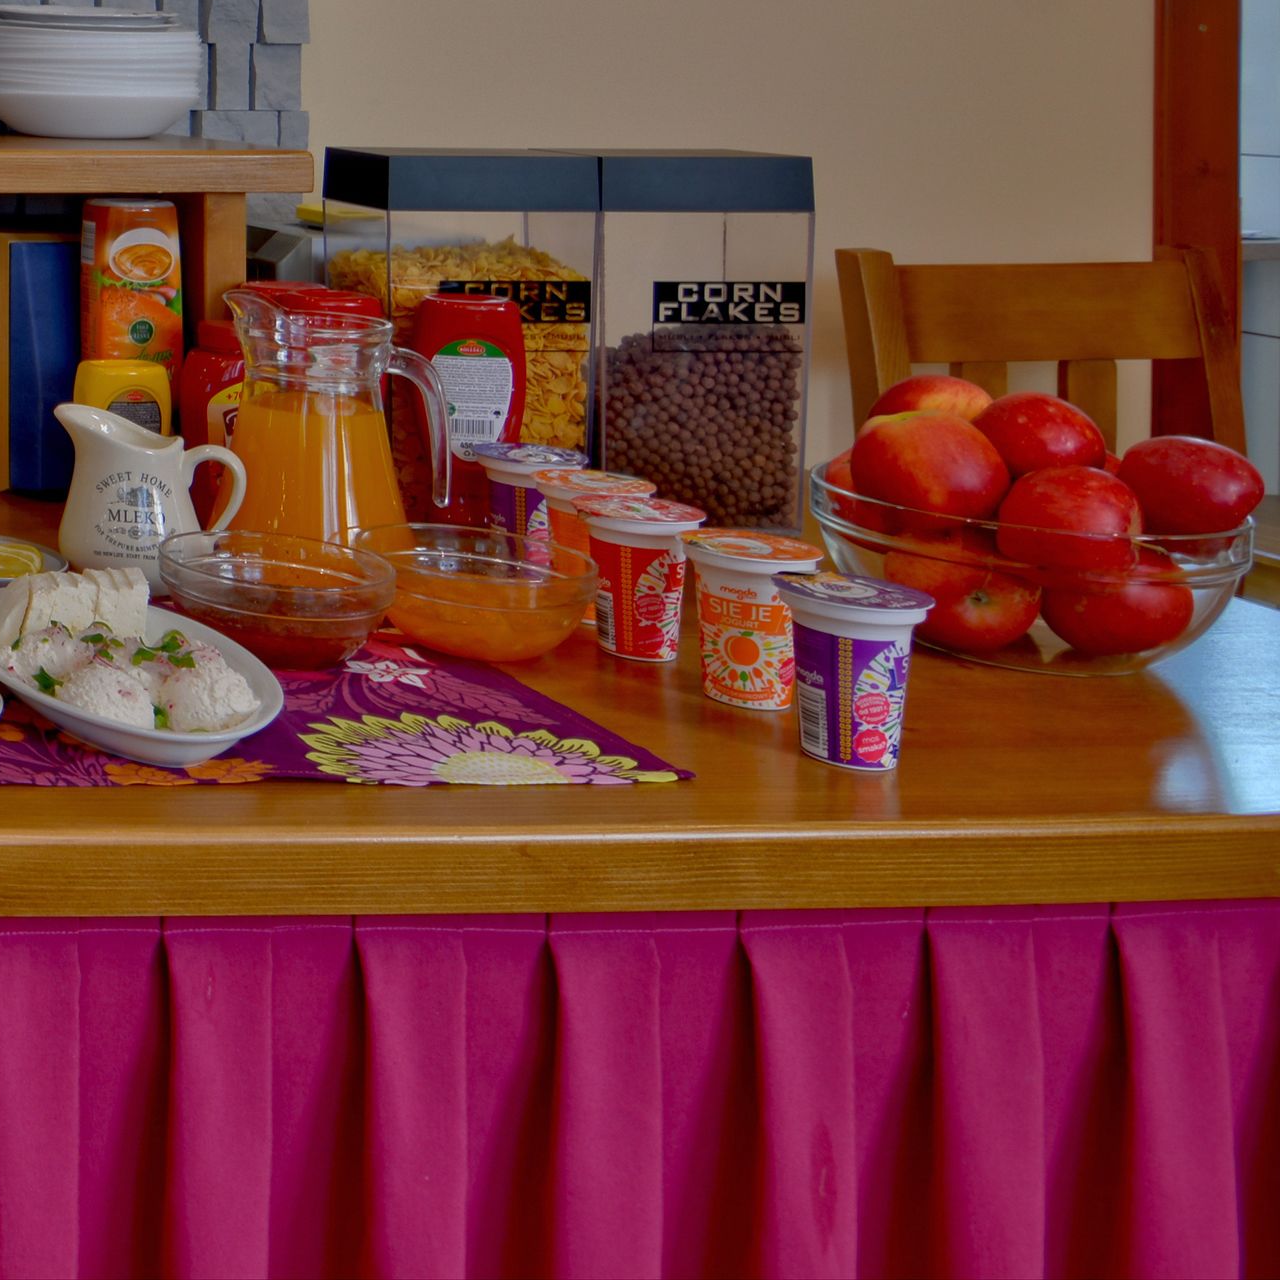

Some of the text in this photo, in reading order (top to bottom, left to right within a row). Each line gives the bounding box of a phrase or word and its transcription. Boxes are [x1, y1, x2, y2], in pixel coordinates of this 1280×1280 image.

[677, 283, 783, 303] CORN
[519, 302, 586, 322] KES
[658, 302, 800, 322] FLAKES
[95, 471, 173, 498] SWEET HOME
[720, 584, 758, 600] magda
[709, 598, 772, 622] SIE JE
[720, 617, 760, 629] JOGURT
